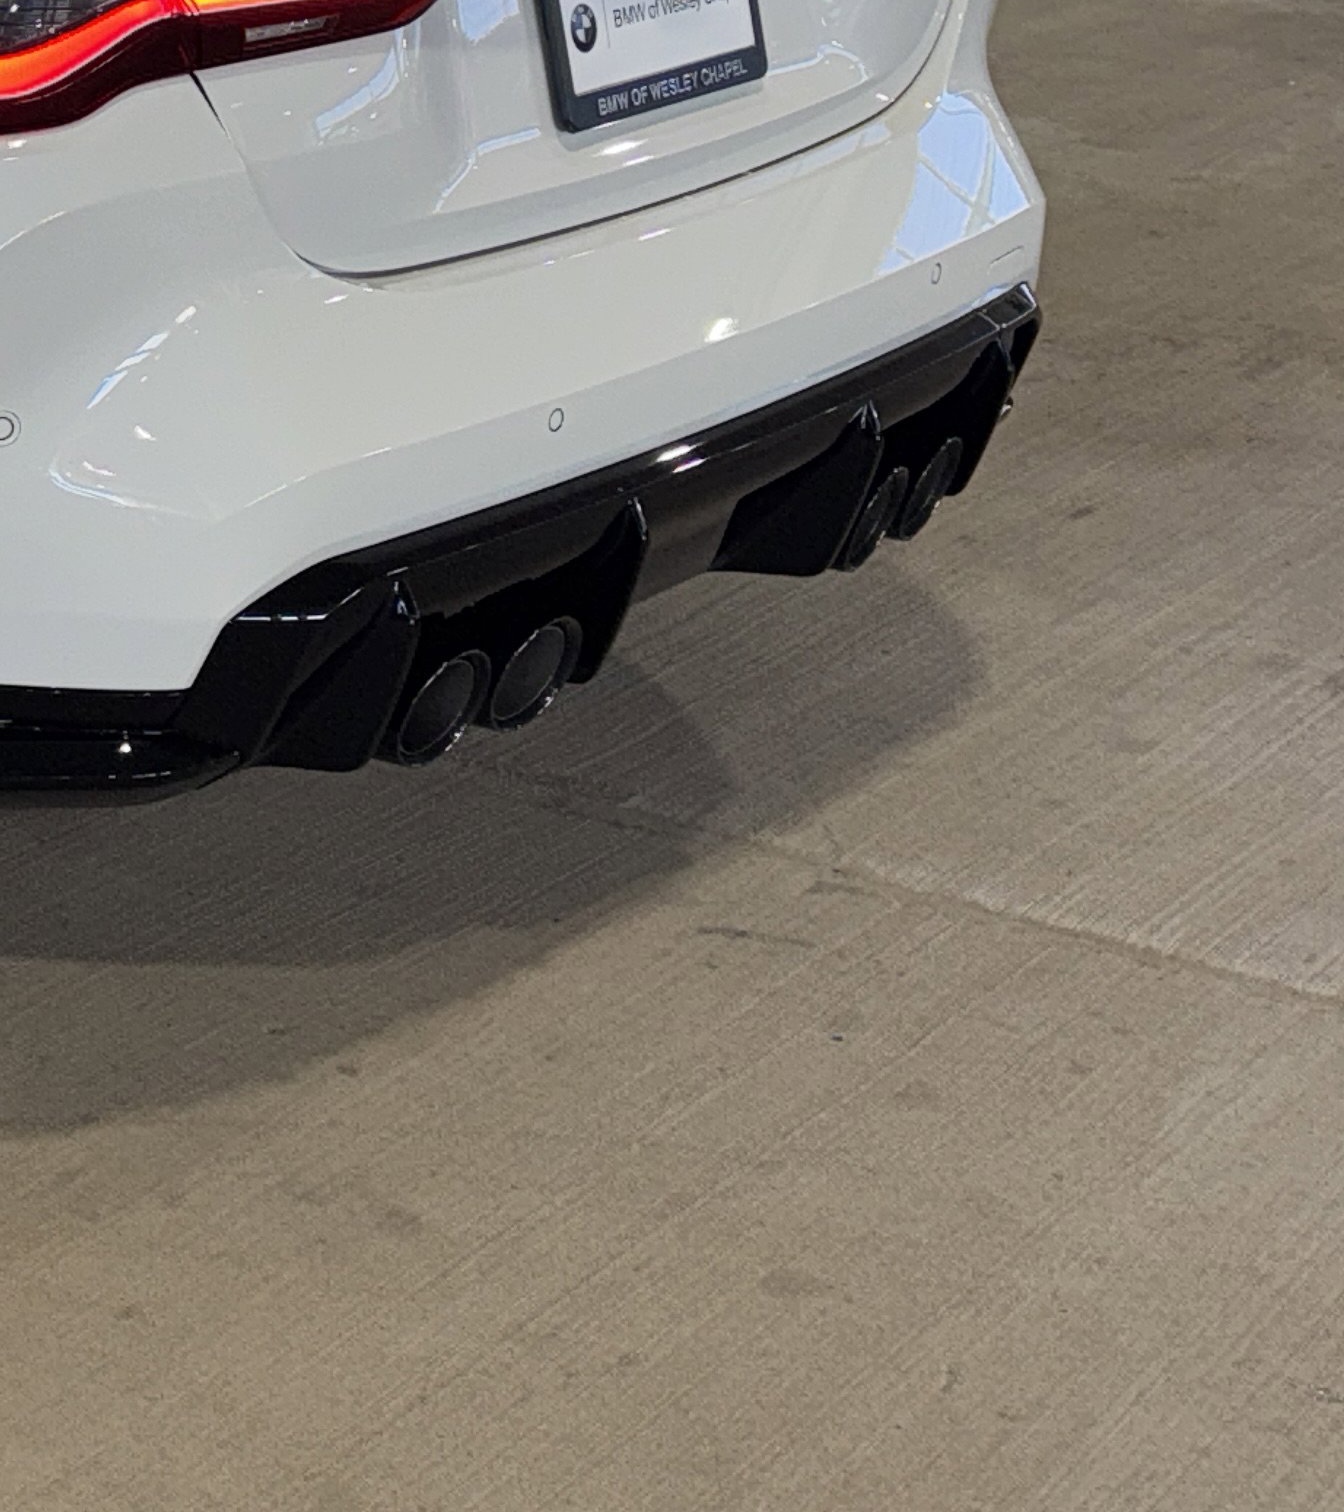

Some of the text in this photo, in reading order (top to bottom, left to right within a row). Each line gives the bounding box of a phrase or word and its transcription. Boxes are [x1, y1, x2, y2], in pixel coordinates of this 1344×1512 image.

[613, 2, 646, 28] BMW
[597, 58, 748, 116] BMW OF WESLEY CHAPEL
